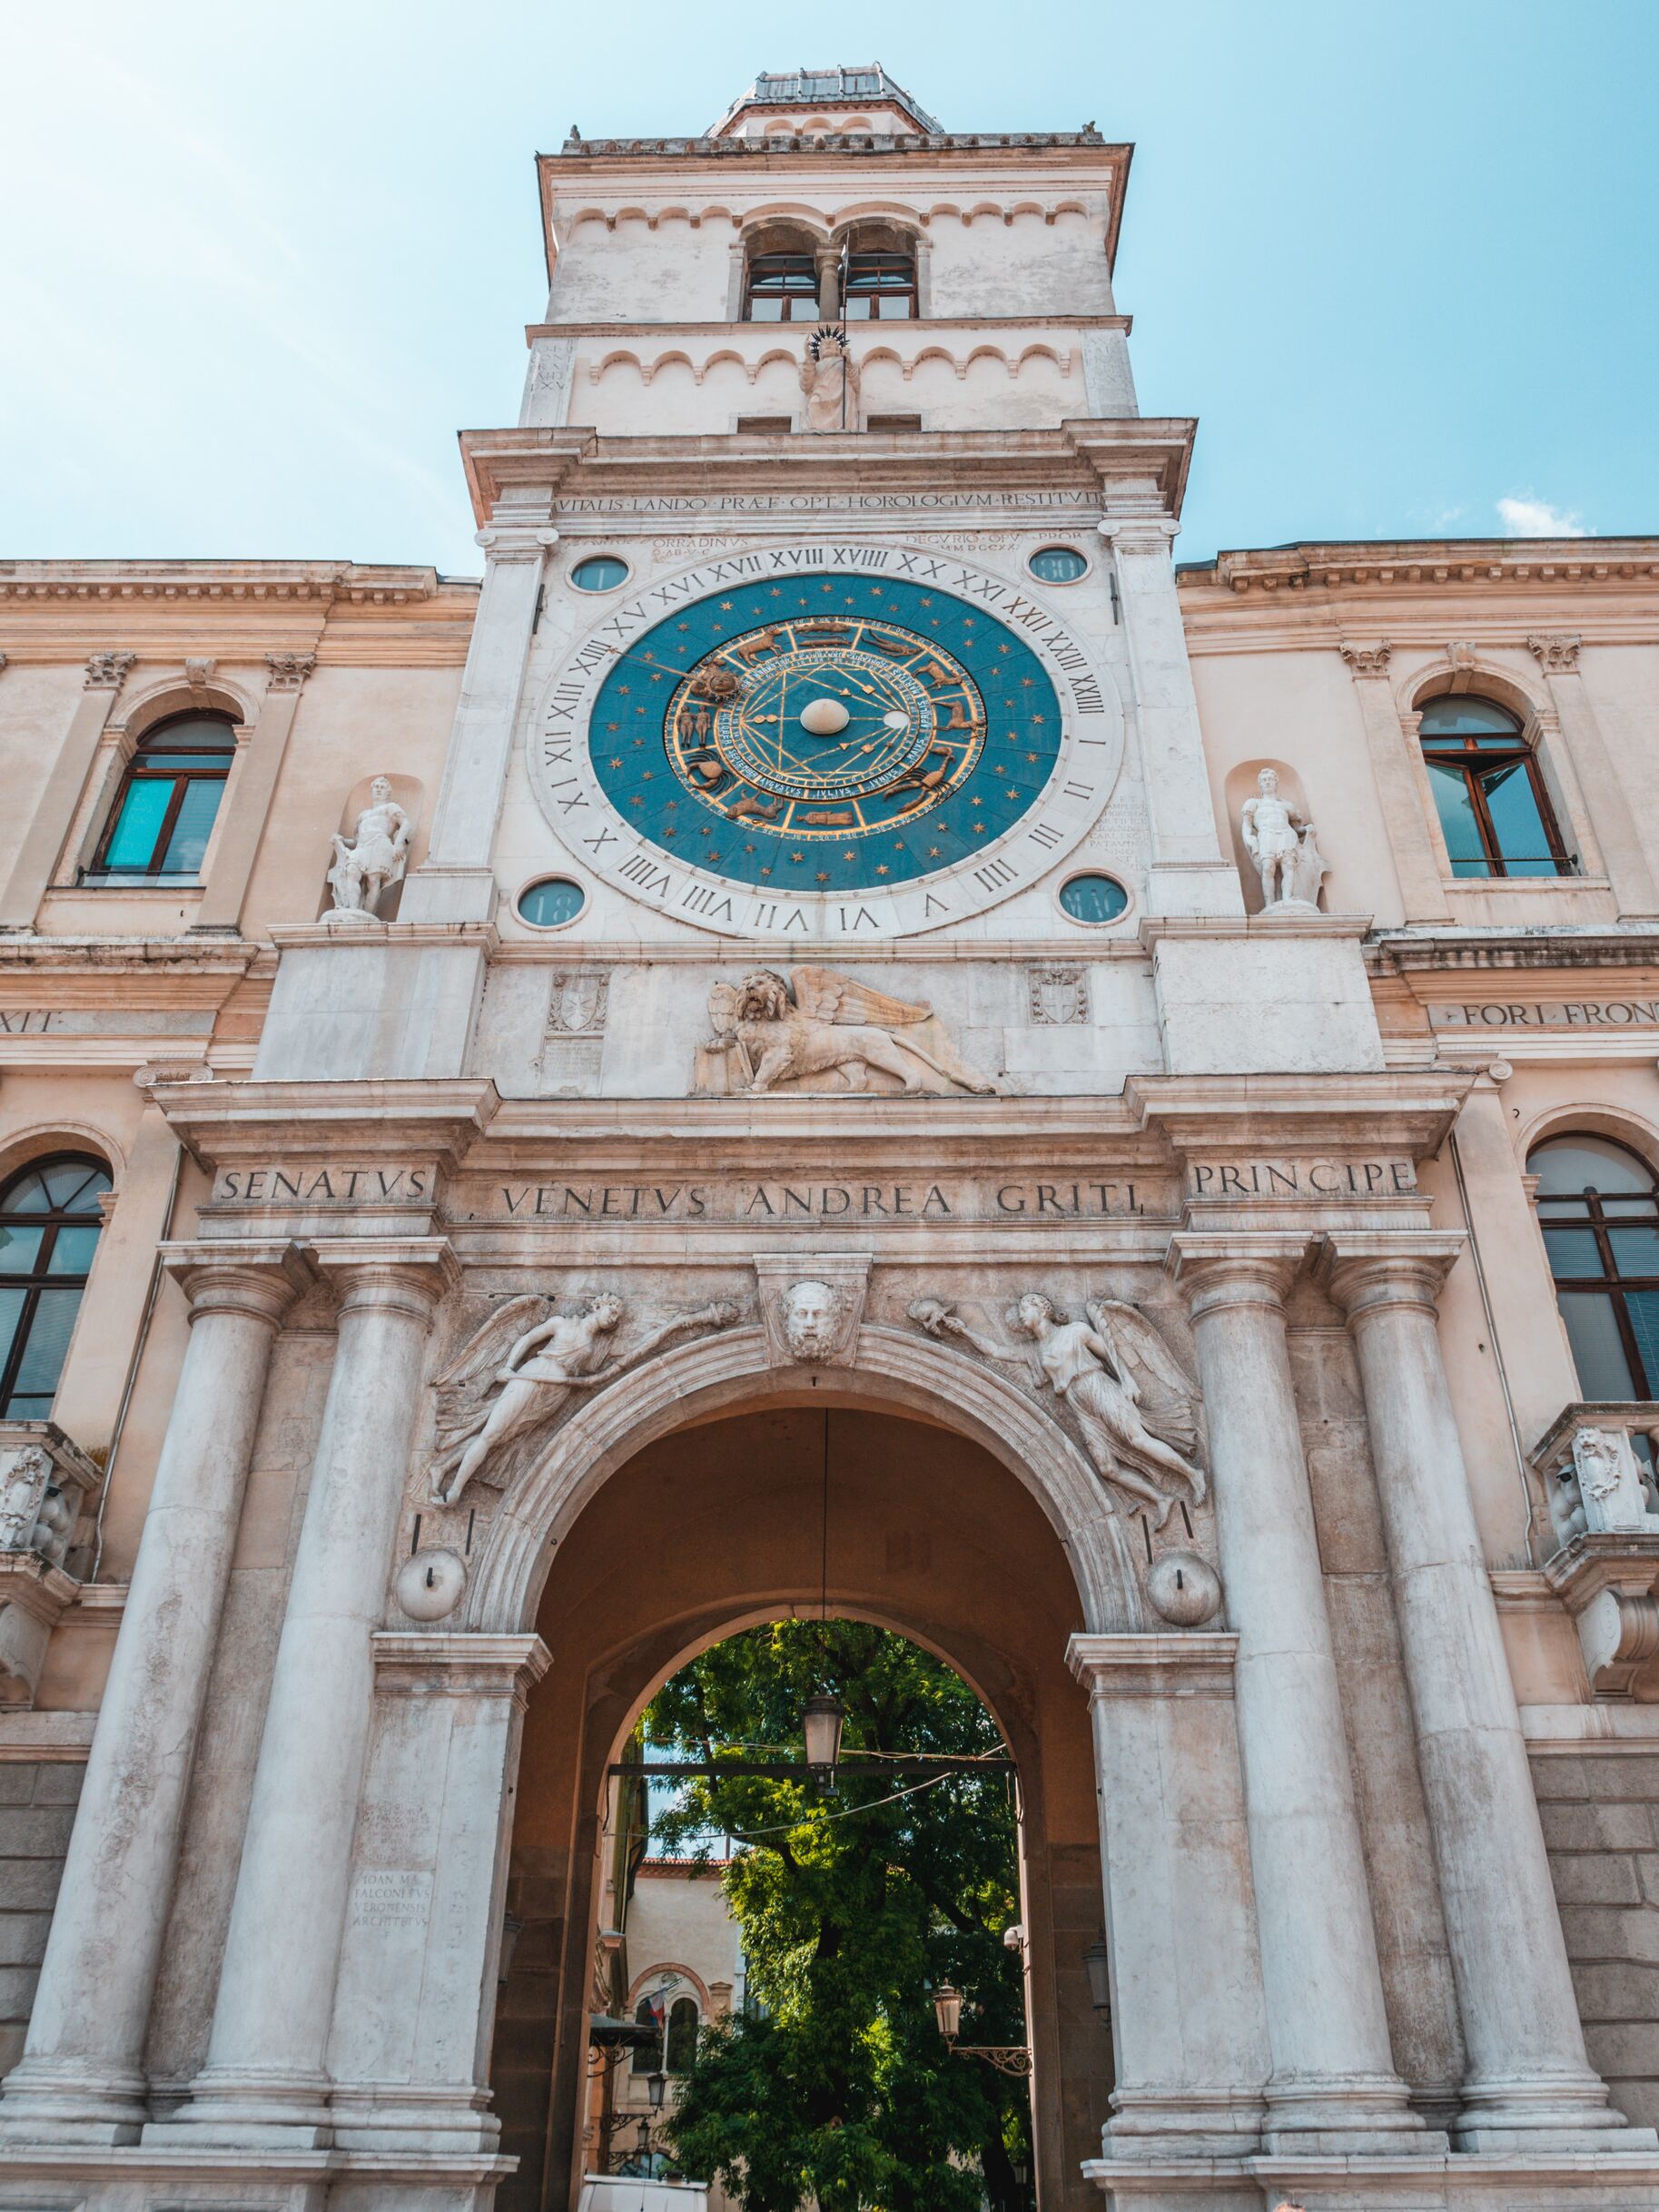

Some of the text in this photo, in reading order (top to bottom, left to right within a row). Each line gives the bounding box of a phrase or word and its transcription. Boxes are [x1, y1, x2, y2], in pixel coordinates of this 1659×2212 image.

[558, 499, 624, 511] VITALIS
[633, 498, 707, 511] LANDO
[848, 494, 992, 509] HOROLOGIVM
[706, 556, 762, 582] XVII
[770, 548, 823, 568] XVIII
[833, 548, 889, 568] XVIIII
[896, 554, 947, 578] XX
[1040, 558, 1075, 580] 30
[649, 574, 706, 606] XVI
[952, 569, 1007, 601] XXI
[602, 602, 647, 637] XV
[1002, 596, 1053, 633] XXII
[568, 639, 612, 676] XIIII
[1041, 630, 1088, 671] XXIII
[548, 683, 585, 720] XIII
[1069, 674, 1105, 714] XXIIII
[917, 700, 930, 729] APRILIS
[545, 731, 572, 766] XII
[728, 748, 759, 778] SEPTEMBER
[906, 738, 925, 762] MAIVS
[551, 777, 590, 815] XI
[759, 776, 802, 795] AVGVSTVS
[816, 787, 852, 797] IVLIVS
[583, 826, 618, 854] X
[1028, 823, 1064, 849] III
[617, 854, 671, 898] VIIII
[973, 858, 1019, 892] IIII
[535, 893, 572, 923] 18
[681, 885, 733, 922] VIII
[754, 903, 809, 932] VII
[924, 893, 950, 917] V
[839, 906, 880, 931] VI
[1463, 1002, 1659, 1024] FORI FRON
[220, 1170, 426, 1200] SENATVS
[500, 1186, 706, 1216] VENETVS
[744, 1183, 952, 1215] ANDREA
[1194, 1161, 1414, 1194] PRINCIPE
